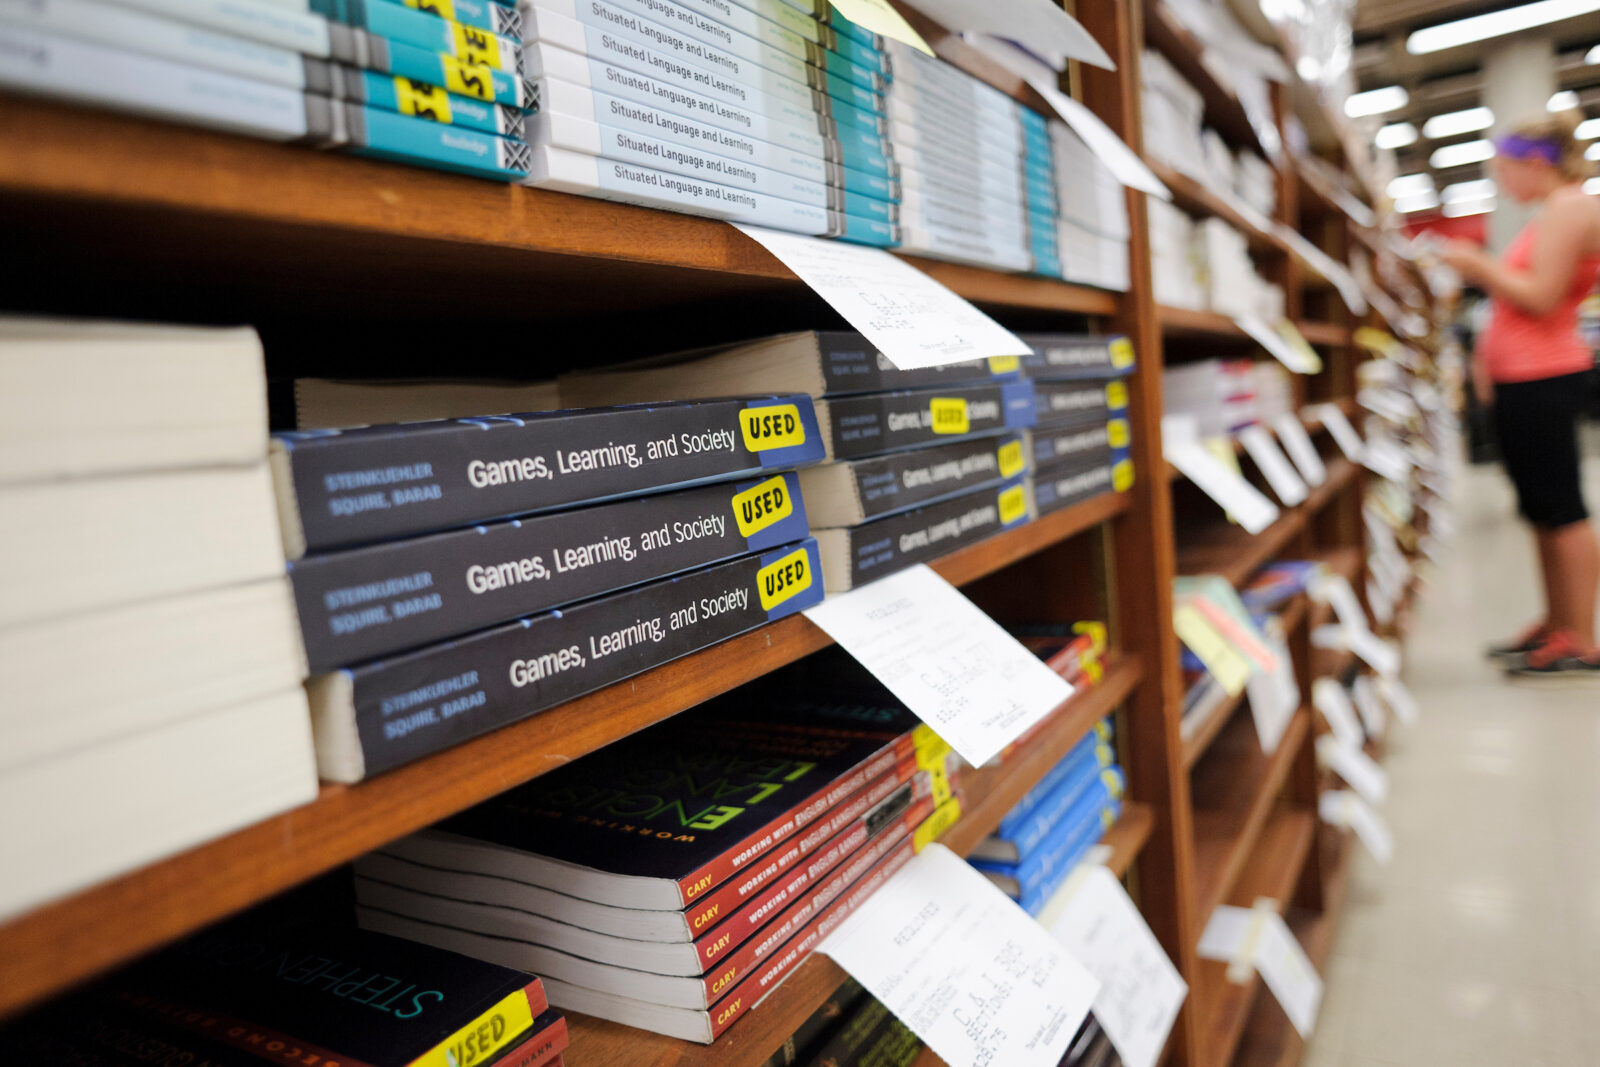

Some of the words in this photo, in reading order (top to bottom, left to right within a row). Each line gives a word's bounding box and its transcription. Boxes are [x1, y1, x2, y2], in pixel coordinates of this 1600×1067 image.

[592, 2, 636, 30] Situated
[638, 20, 684, 50] Language
[686, 42, 702, 57] and
[703, 47, 740, 73] Learning
[678, 11, 694, 25] and
[695, 16, 732, 43] Learning
[602, 34, 646, 62] Situated
[647, 52, 692, 79] Language
[694, 71, 710, 86] and
[711, 77, 747, 101] Learning
[606, 67, 650, 92] Situated
[652, 83, 697, 109] Language
[699, 98, 715, 114] and
[716, 104, 751, 127] Learning
[610, 101, 653, 124] Situated
[656, 114, 700, 139] Language
[702, 129, 717, 143] and
[719, 133, 754, 154] Learning
[614, 165, 657, 186] Situated
[659, 175, 702, 197] Language
[705, 187, 720, 200] and
[722, 189, 757, 208] Learning
[617, 134, 659, 155] Situated
[661, 145, 704, 169] Language
[706, 159, 721, 172] and
[723, 162, 757, 184] Learning
[749, 413, 796, 439] USED
[467, 456, 553, 489] Games,
[556, 442, 644, 475] Learning,
[647, 433, 679, 459] and
[682, 428, 735, 452] Society
[742, 487, 784, 524] USED
[466, 558, 551, 595] Games,
[553, 536, 638, 573] Learning,
[641, 526, 671, 552] and
[675, 514, 726, 544] Society
[765, 559, 805, 597] USED
[509, 643, 586, 688] Games,
[589, 618, 666, 660] Learning,
[670, 604, 697, 630] and
[701, 587, 749, 619] Society
[686, 874, 712, 898] CARY
[732, 835, 773, 867] WORKING
[772, 823, 795, 841] WITH
[795, 796, 829, 827] ENGLISH
[694, 904, 719, 929] CARY
[738, 863, 778, 896] WORKING
[778, 848, 799, 868] WITH
[706, 933, 731, 959] CARY
[748, 890, 787, 924] WORKING
[787, 874, 808, 894] WITH
[712, 967, 737, 994] CARY
[755, 921, 792, 957] WORKING
[792, 903, 812, 924] WITH
[717, 998, 742, 1026] CARY
[760, 949, 797, 987] WORKING
[797, 931, 817, 952] WITH
[953, 1006, 972, 1027] C
